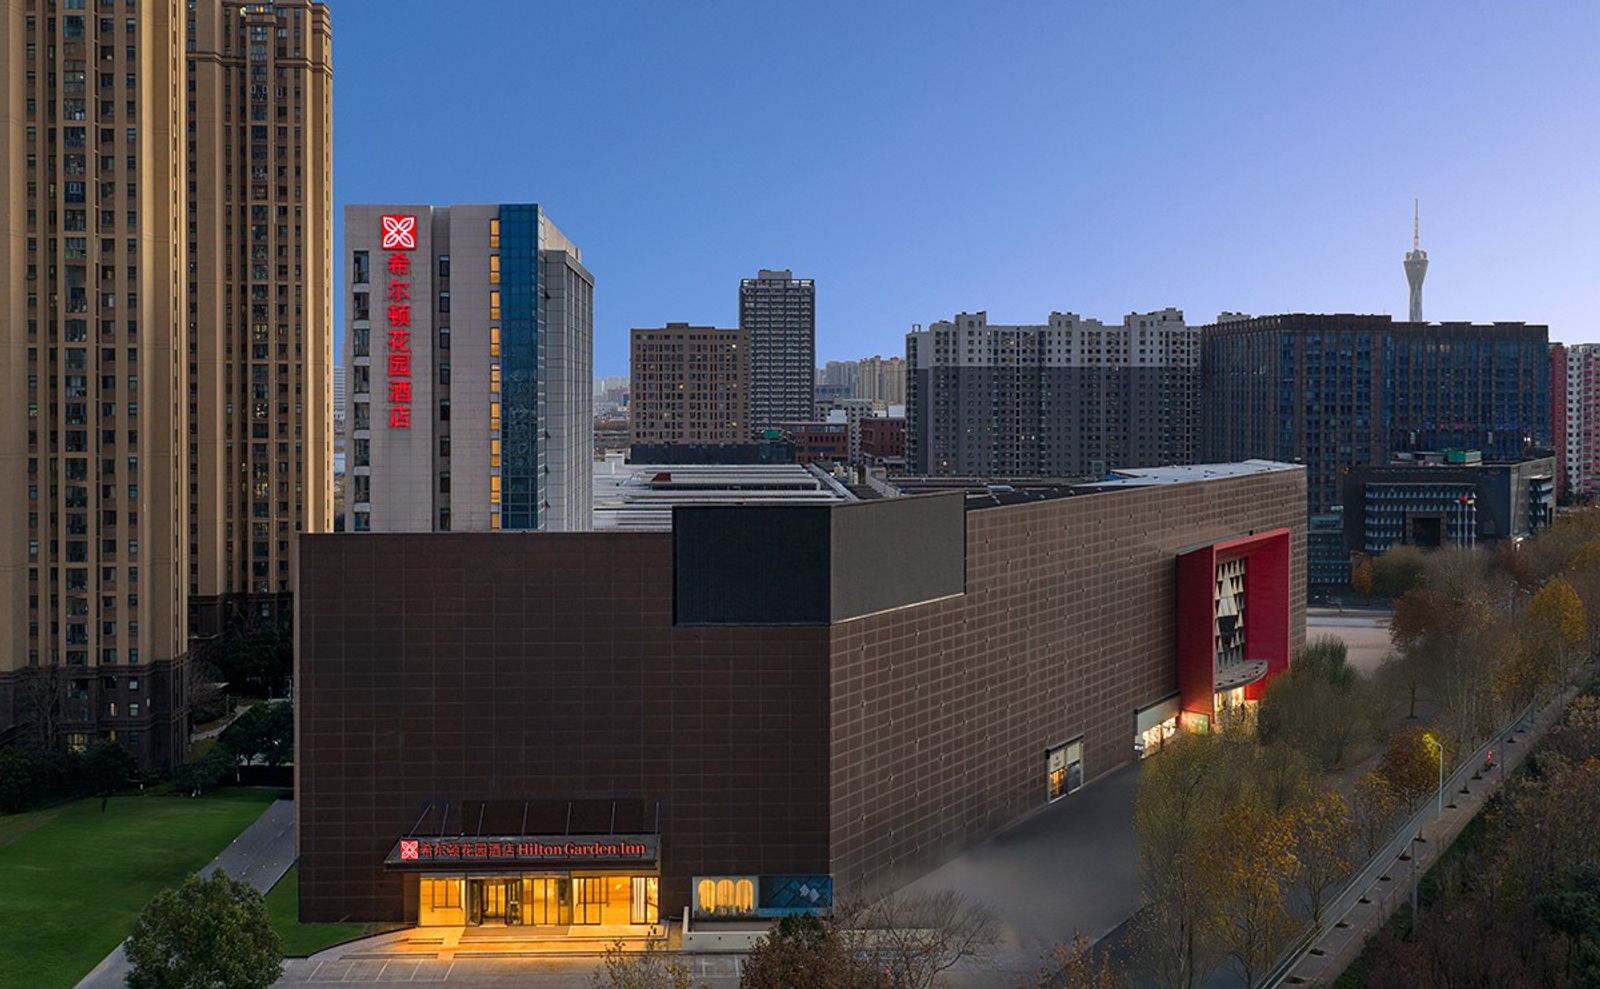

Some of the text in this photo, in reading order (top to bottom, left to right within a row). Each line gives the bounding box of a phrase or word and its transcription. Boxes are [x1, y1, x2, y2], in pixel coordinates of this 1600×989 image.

[387, 253, 411, 428] 希尔顿花园酒店
[518, 841, 647, 856] Hilton Garden Inn
